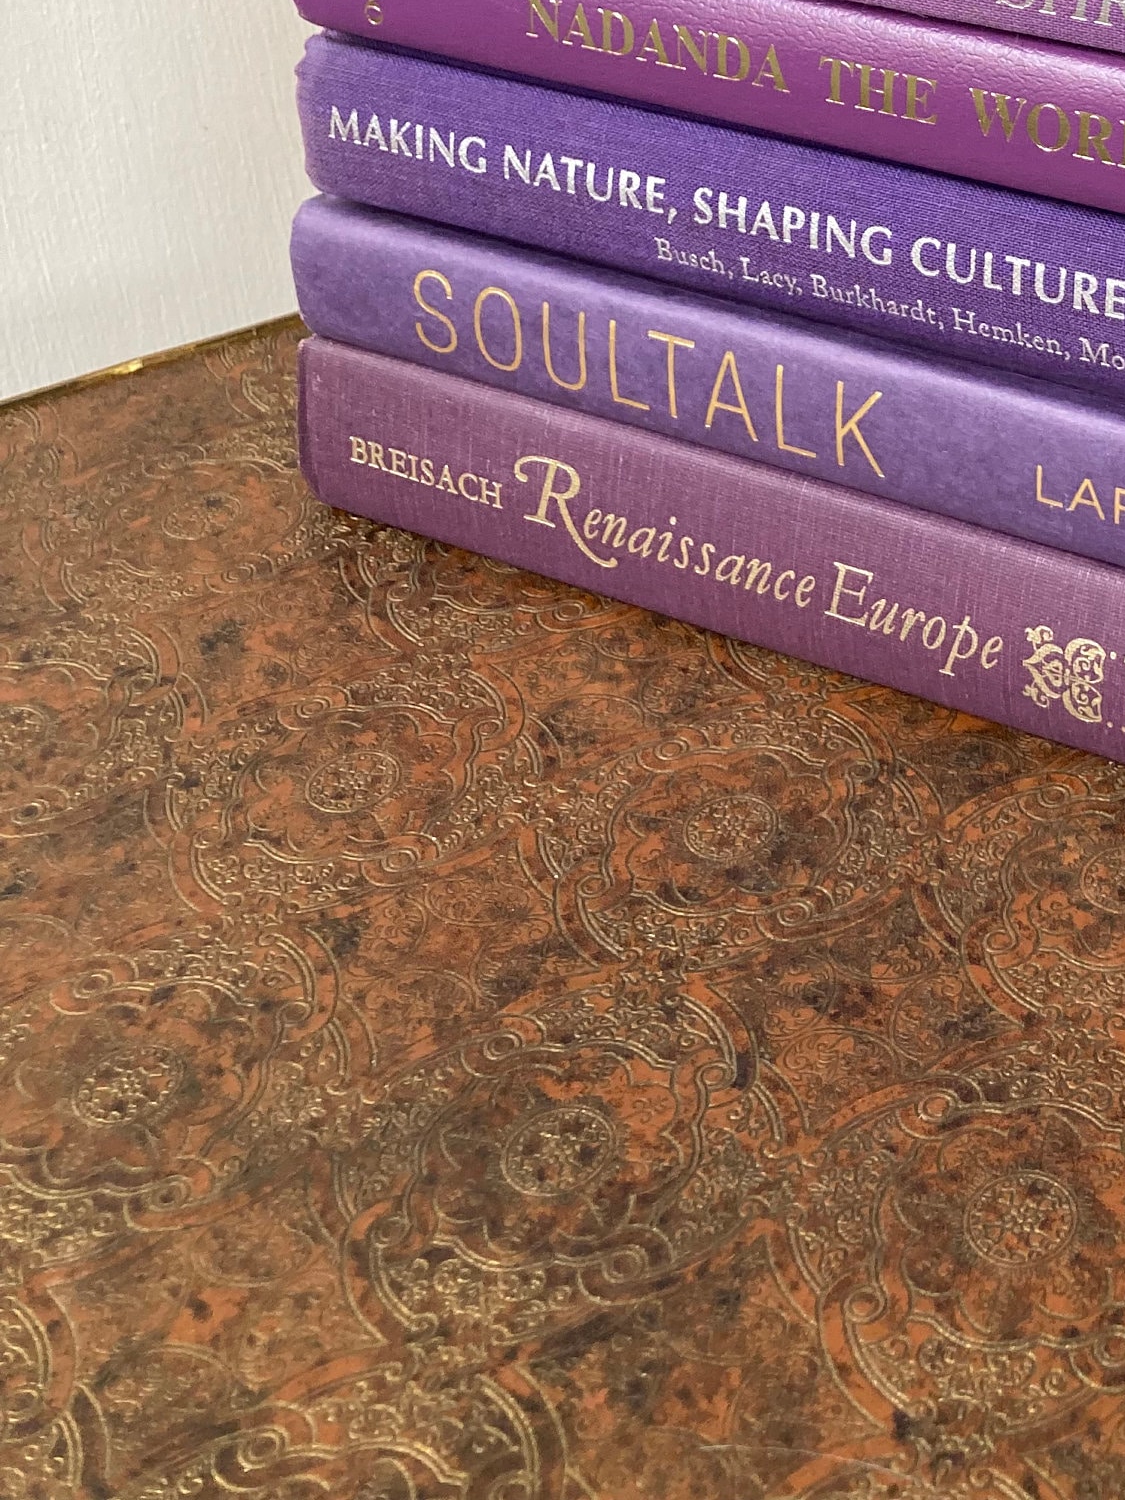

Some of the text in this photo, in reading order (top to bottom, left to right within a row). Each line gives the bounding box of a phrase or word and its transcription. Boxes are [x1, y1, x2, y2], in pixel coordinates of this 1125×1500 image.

[818, 56, 939, 126] THE
[327, 105, 488, 174] MAKING
[502, 144, 679, 224] NATURE,
[692, 187, 894, 267] SHAPING
[412, 269, 885, 479] SOULTALK
[653, 237, 735, 279] Busch,
[741, 257, 804, 297] Lacy,
[811, 273, 945, 330] Burkhardt,
[952, 308, 1071, 361] Hemken,
[348, 436, 1005, 678] BREISACH Renaissance Europe
